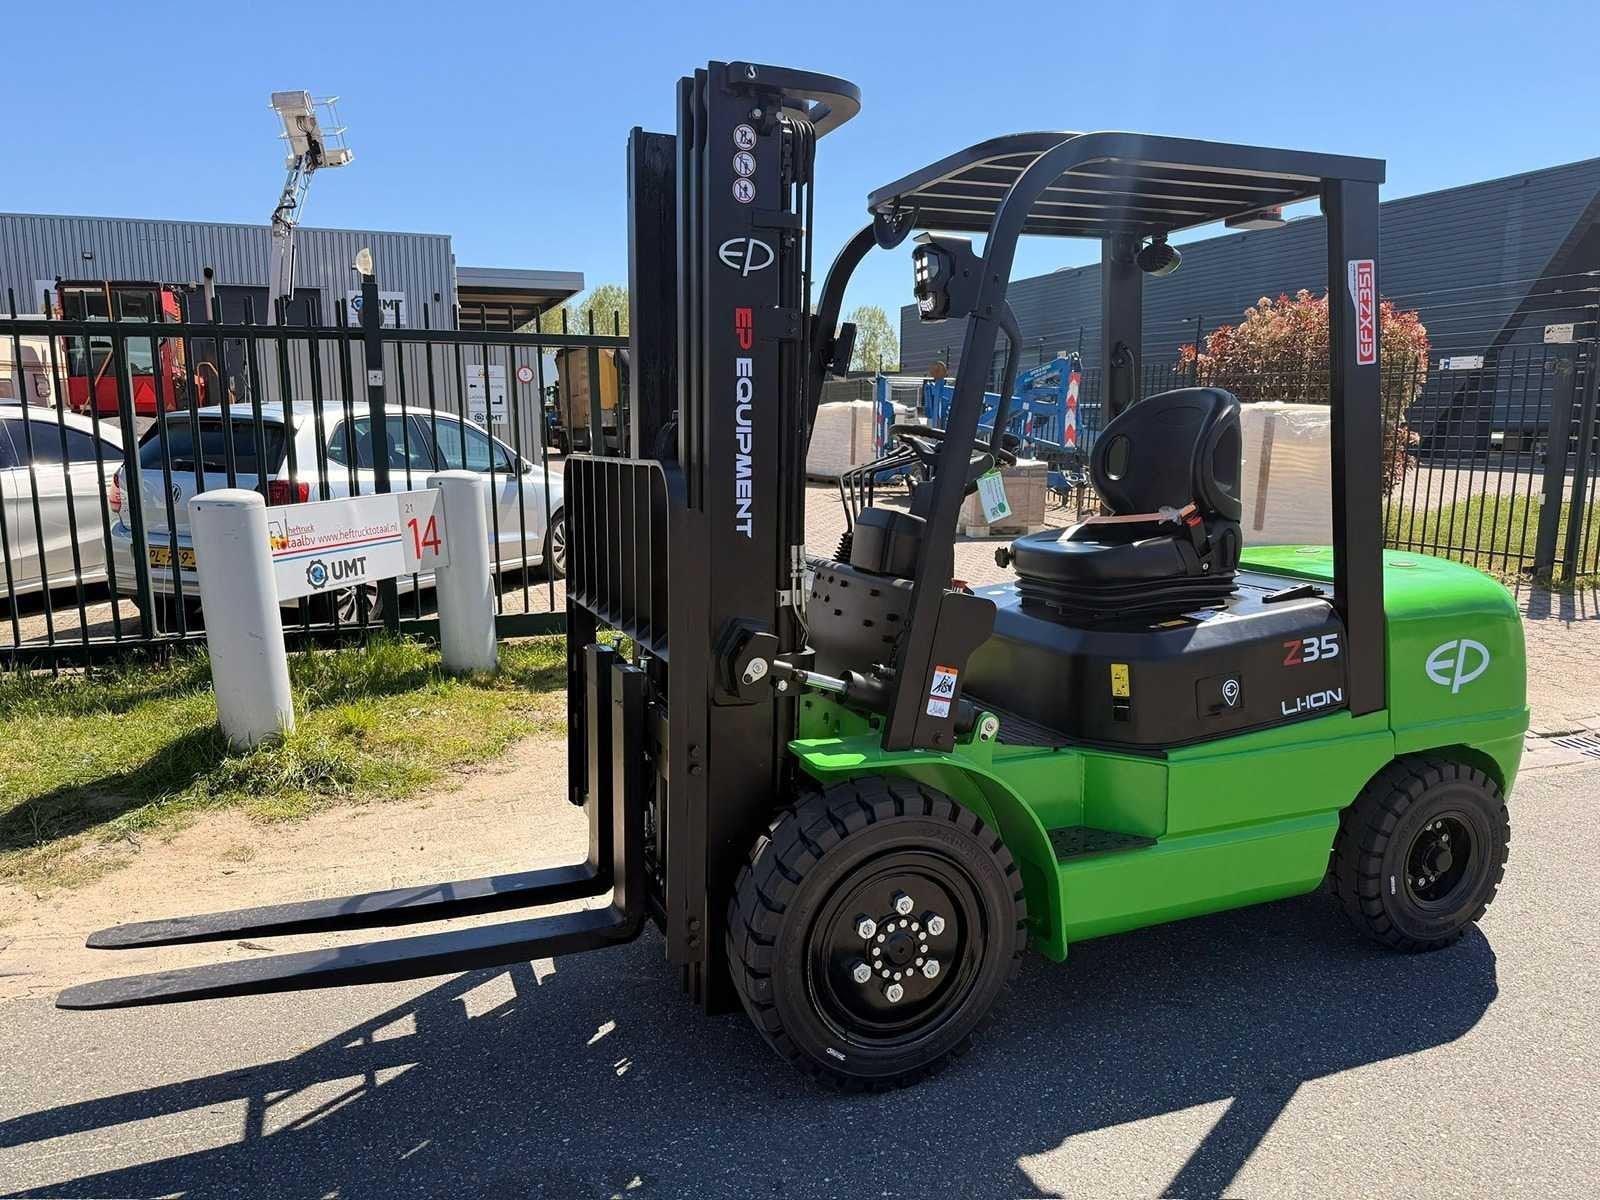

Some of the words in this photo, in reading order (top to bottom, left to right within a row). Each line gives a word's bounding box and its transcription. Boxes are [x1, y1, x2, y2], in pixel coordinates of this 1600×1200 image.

[718, 237, 775, 277] EP
[378, 299, 403, 310] MT
[1359, 267, 1373, 357] EFXZ351
[735, 308, 753, 350] EP
[735, 357, 753, 538] EQUIPMENT
[404, 503, 414, 514] 21
[318, 521, 398, 544] www.heftrucktotaal.nl
[407, 514, 442, 560] 14
[331, 556, 367, 581] UMT
[1283, 633, 1340, 666] Z35
[1425, 639, 1490, 694] EP
